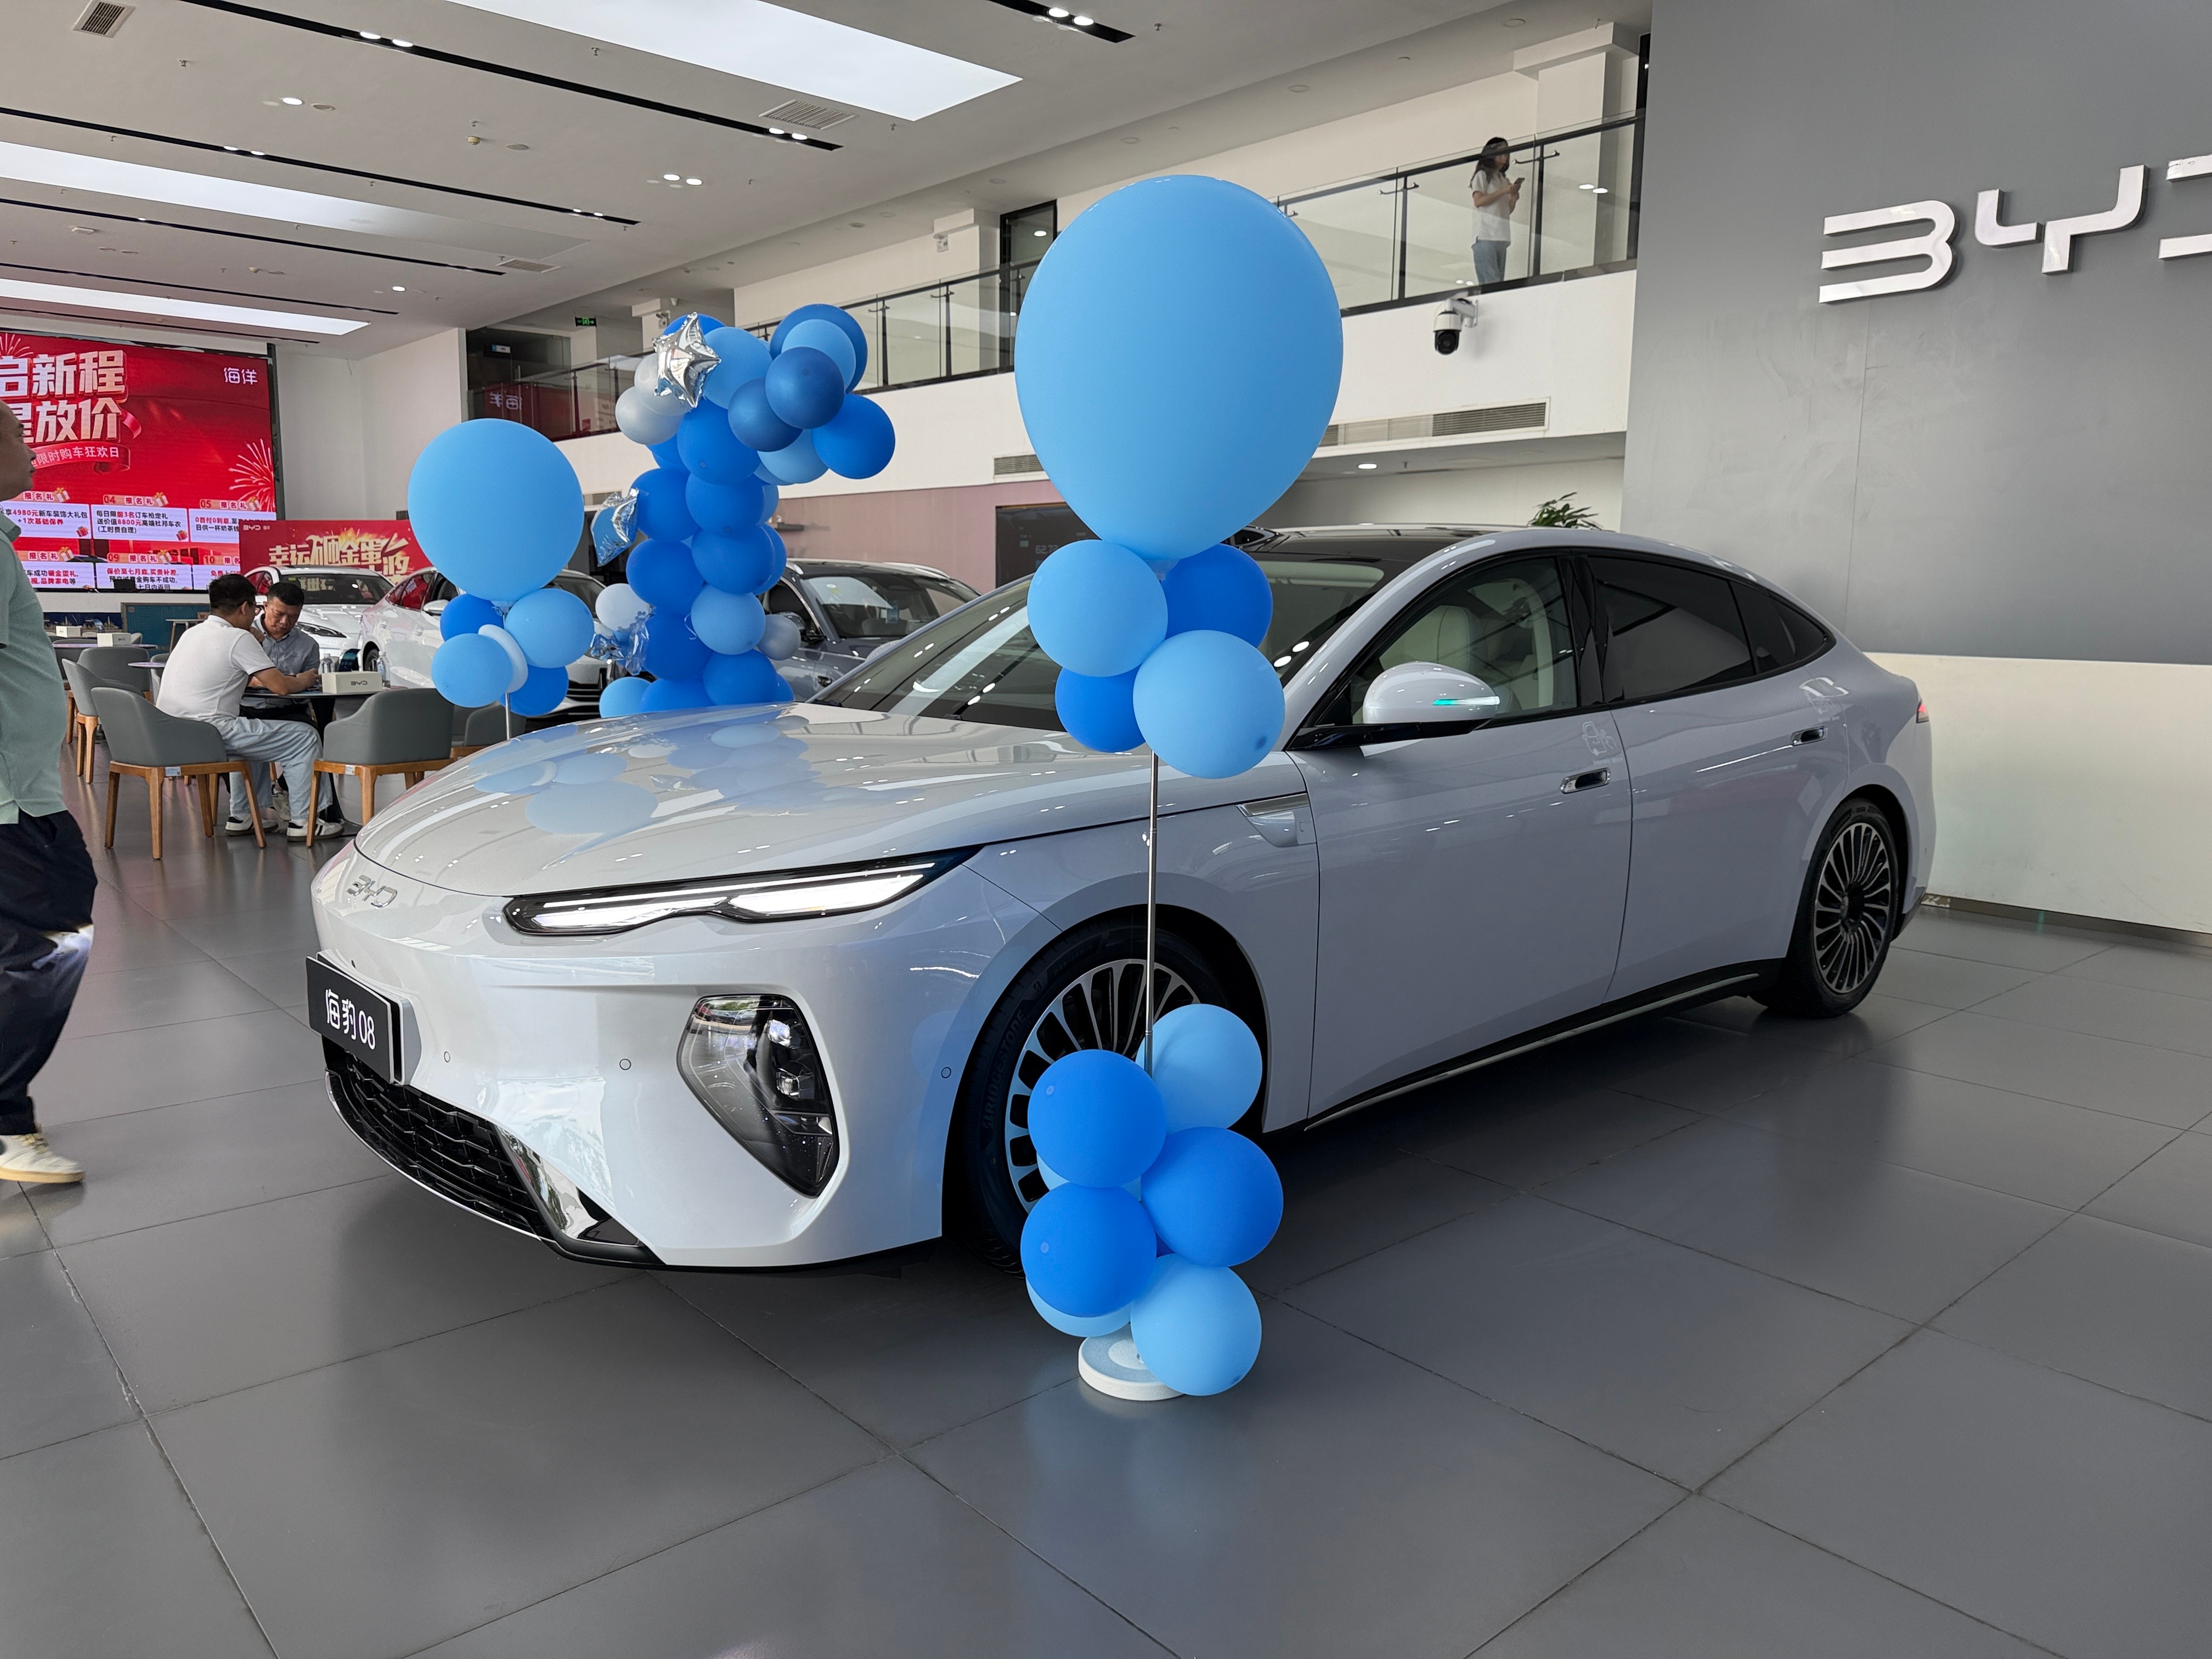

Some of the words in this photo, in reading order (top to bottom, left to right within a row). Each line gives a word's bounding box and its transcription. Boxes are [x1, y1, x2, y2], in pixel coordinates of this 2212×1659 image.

[224, 367, 258, 385] 海洋
[31, 446, 119, 466] 限时购车狂欢日
[24, 492, 54, 501] 报名礼
[104, 495, 116, 504] 04
[200, 500, 212, 508] 05
[204, 556, 215, 564] 10
[346, 874, 398, 909] BYD
[981, 1009, 1026, 1129] BRIDGESTONE
